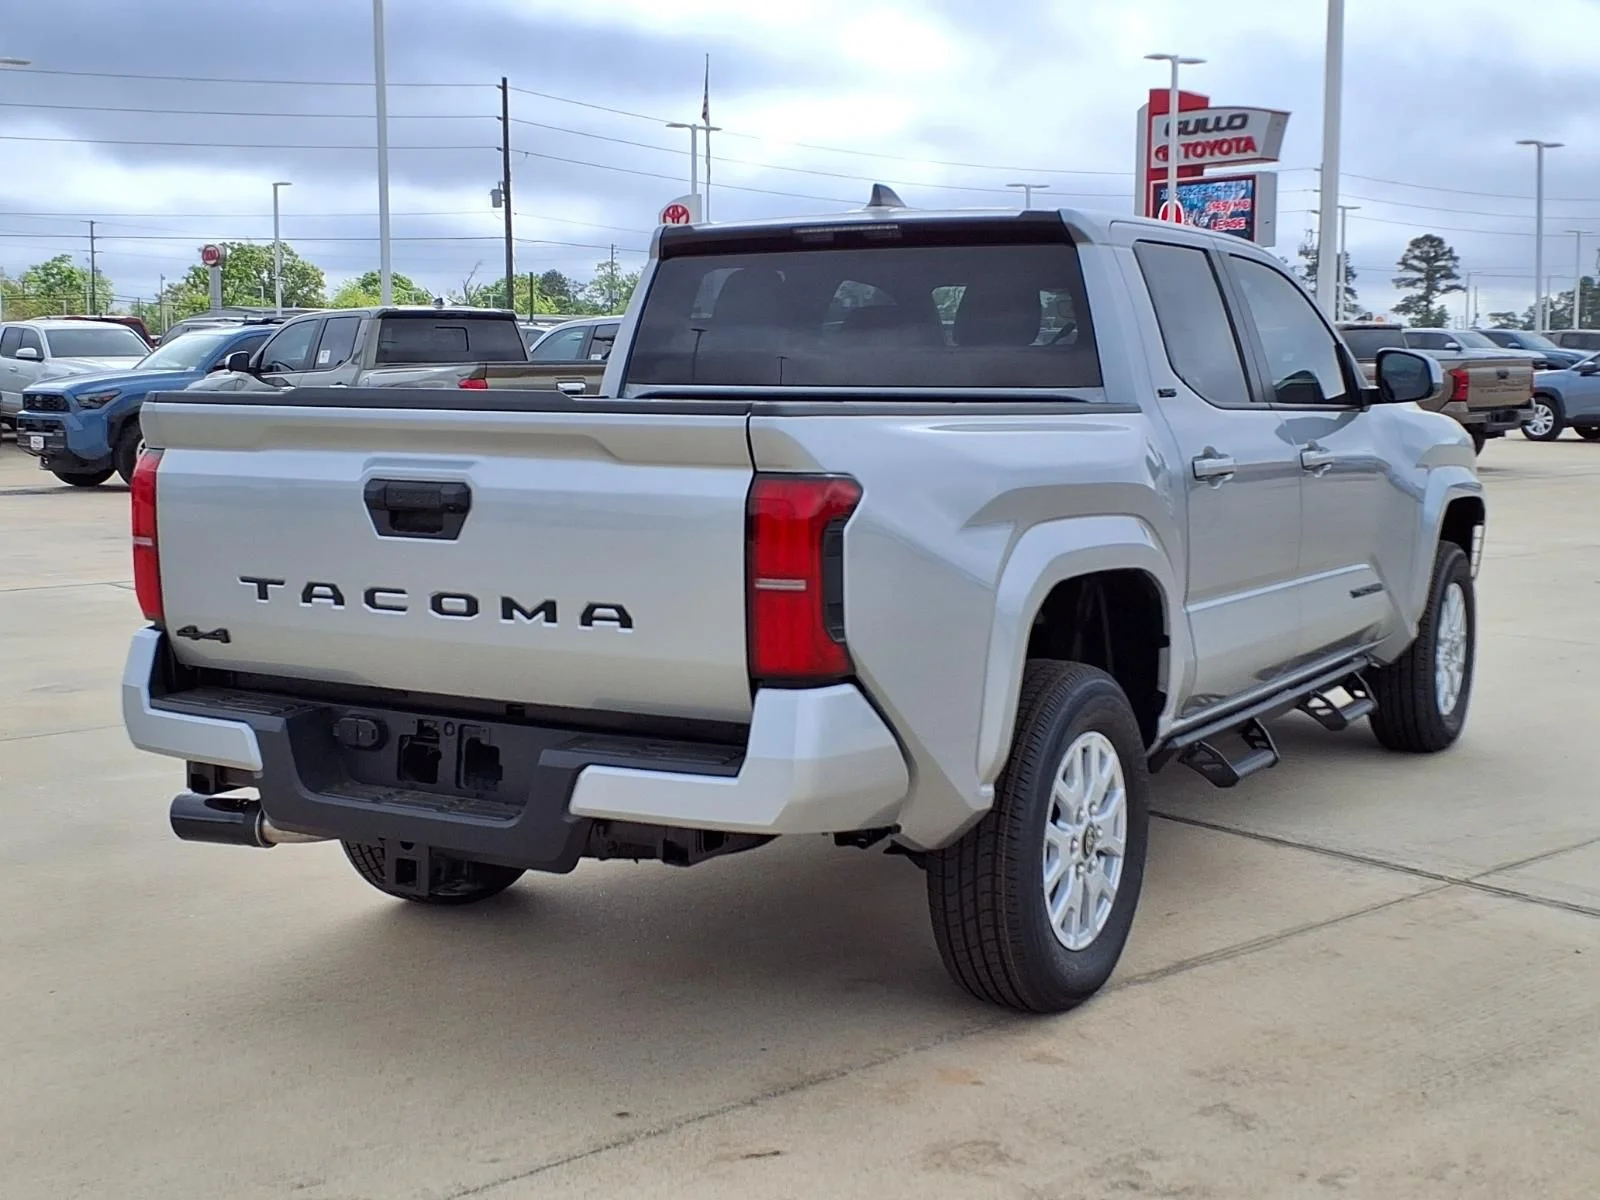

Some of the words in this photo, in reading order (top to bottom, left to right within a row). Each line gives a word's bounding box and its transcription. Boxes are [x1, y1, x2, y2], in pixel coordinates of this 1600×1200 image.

[1164, 113, 1249, 137] GULLO
[1180, 136, 1257, 159] TOYOTA
[1210, 218, 1247, 231] LEASE
[238, 575, 634, 631] TACOMA
